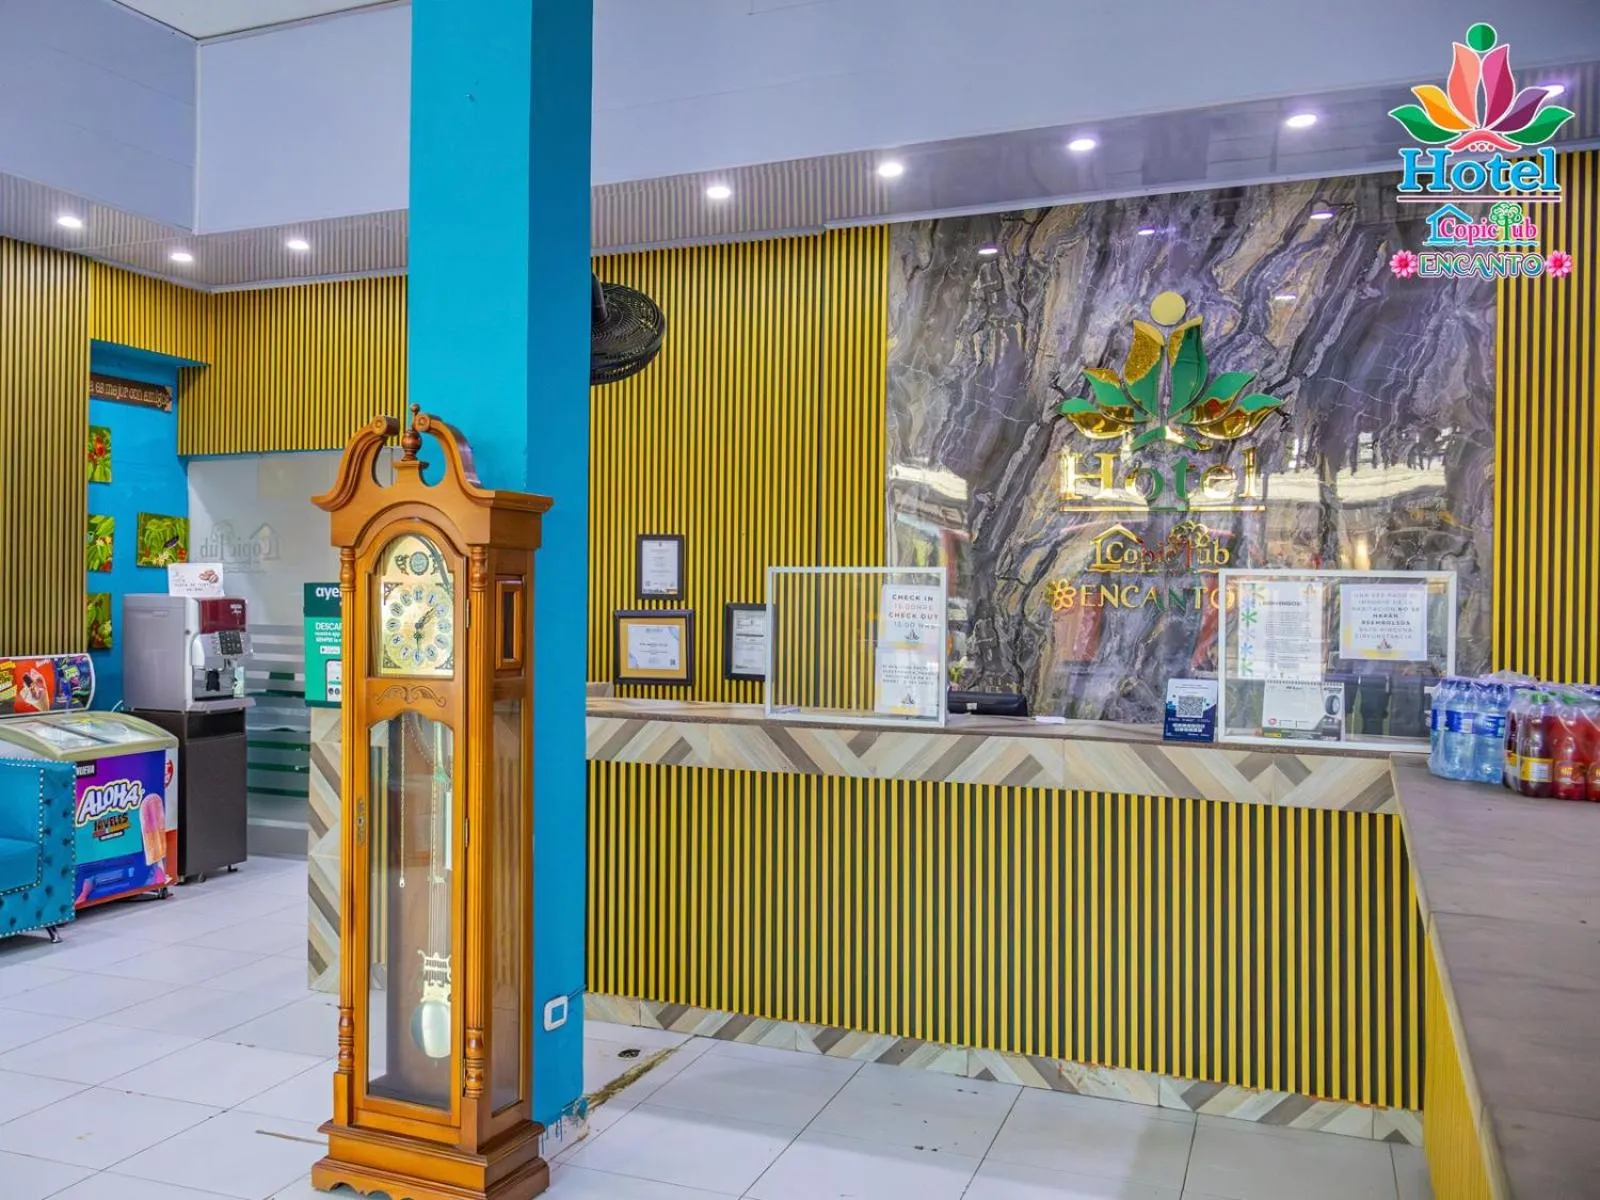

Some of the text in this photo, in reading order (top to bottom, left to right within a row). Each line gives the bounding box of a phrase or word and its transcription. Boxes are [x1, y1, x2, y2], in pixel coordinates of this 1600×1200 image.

[1059, 447, 1260, 502] Hotel
[888, 611, 917, 619] CHECK
[1080, 584, 1235, 612] ENCANTO
[77, 780, 141, 825] ALOHA
